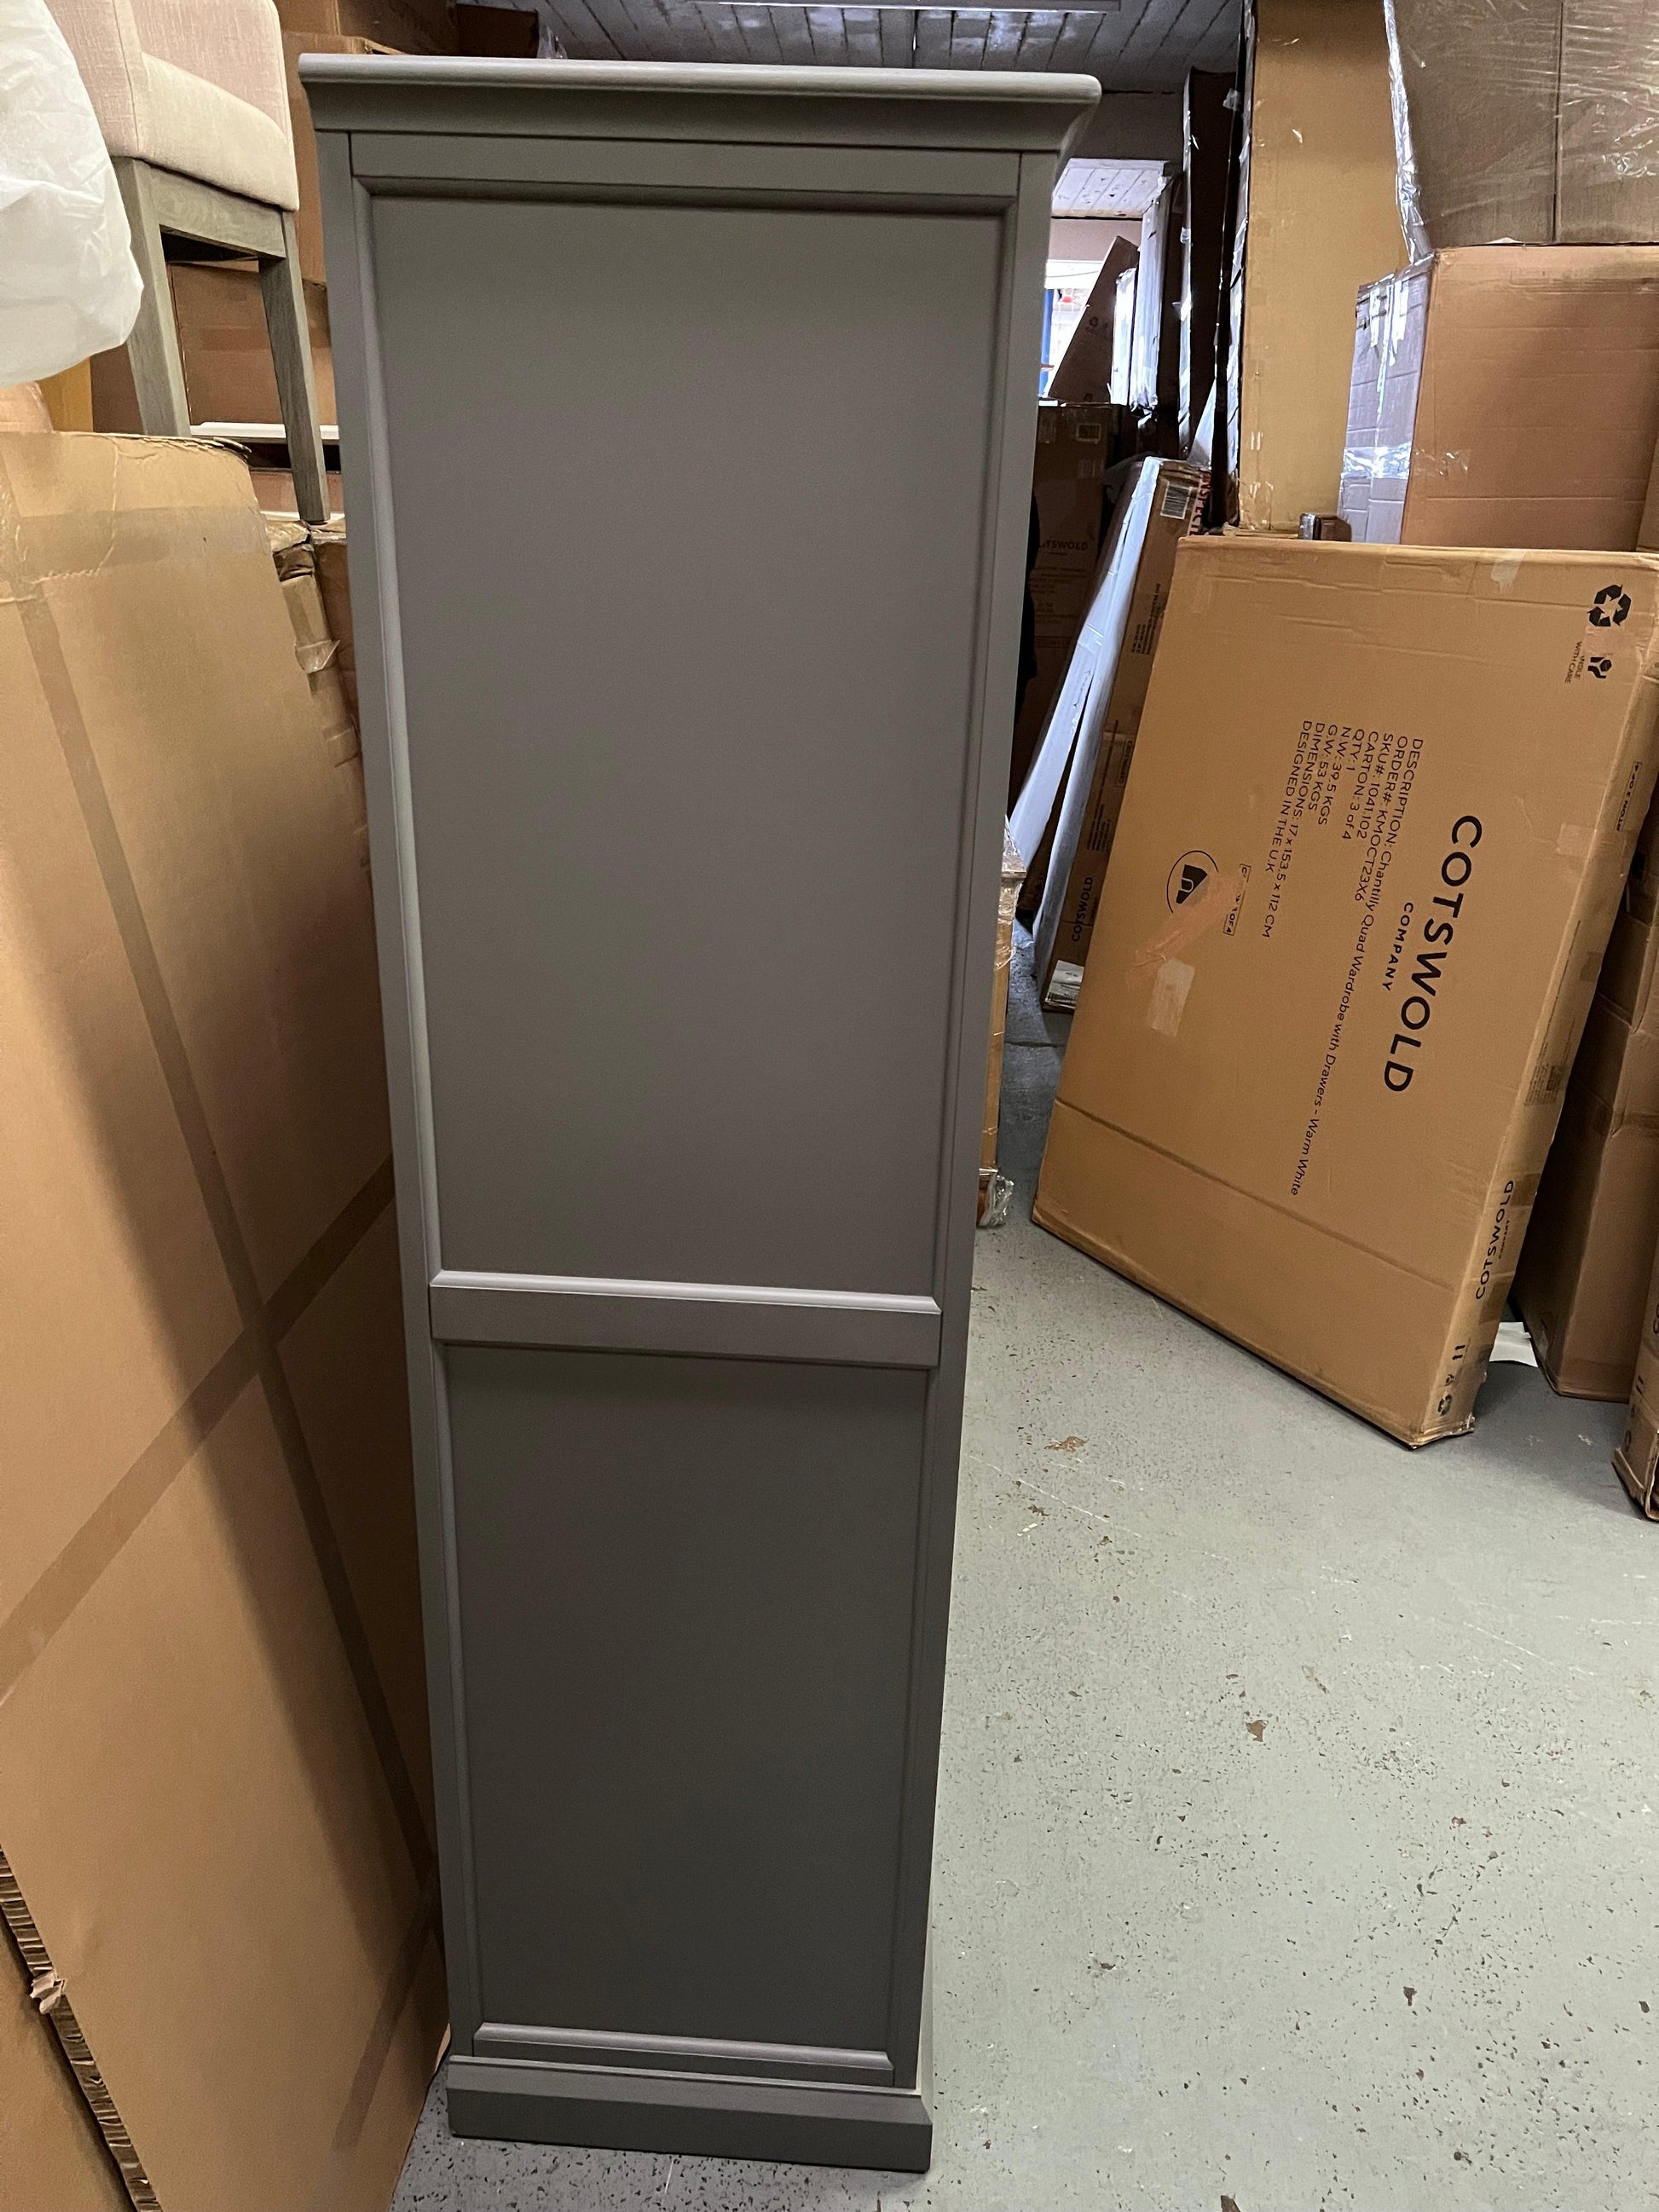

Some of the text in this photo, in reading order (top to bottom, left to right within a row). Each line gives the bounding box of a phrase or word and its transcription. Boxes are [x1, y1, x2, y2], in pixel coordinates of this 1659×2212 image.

[1039, 540, 1089, 551] TSWOLD
[1564, 641, 1582, 684] WITH CARE
[1286, 720, 1312, 797] DESIGNED
[1348, 729, 1364, 762] QTY:
[1373, 733, 1394, 778] SKU#:
[1292, 723, 1325, 820] DIMENSIONS:
[1317, 761, 1328, 777] 53
[1327, 763, 1342, 792] 39.5
[1342, 731, 1379, 840] CARTON: 3 of 4
[1280, 800, 1292, 815] IN
[1308, 782, 1323, 811] KGS
[1318, 796, 1333, 825] KGS
[1384, 738, 1424, 847] DESCRIPTION:
[1272, 819, 1286, 846] THE
[1289, 824, 1298, 836] 17
[1616, 800, 1628, 831] RTON
[1277, 849, 1292, 881] 153.5
[1365, 850, 1391, 912] Chantilly
[1072, 876, 1094, 943] COTSWOLD
[1269, 894, 1280, 911] 112
[1263, 914, 1275, 938] CM
[1356, 914, 1374, 953] Quad
[1382, 902, 1414, 991] COMPANY
[1384, 815, 1483, 1092] COTSWOLD
[1337, 956, 1363, 1021] Wardrobe
[1327, 1024, 1343, 1051] with
[1314, 1054, 1337, 1106] Drawers
[1300, 1118, 1320, 1156] Warm
[1291, 1158, 1309, 1196] White
[1476, 1180, 1514, 1299] COTSWOLD
